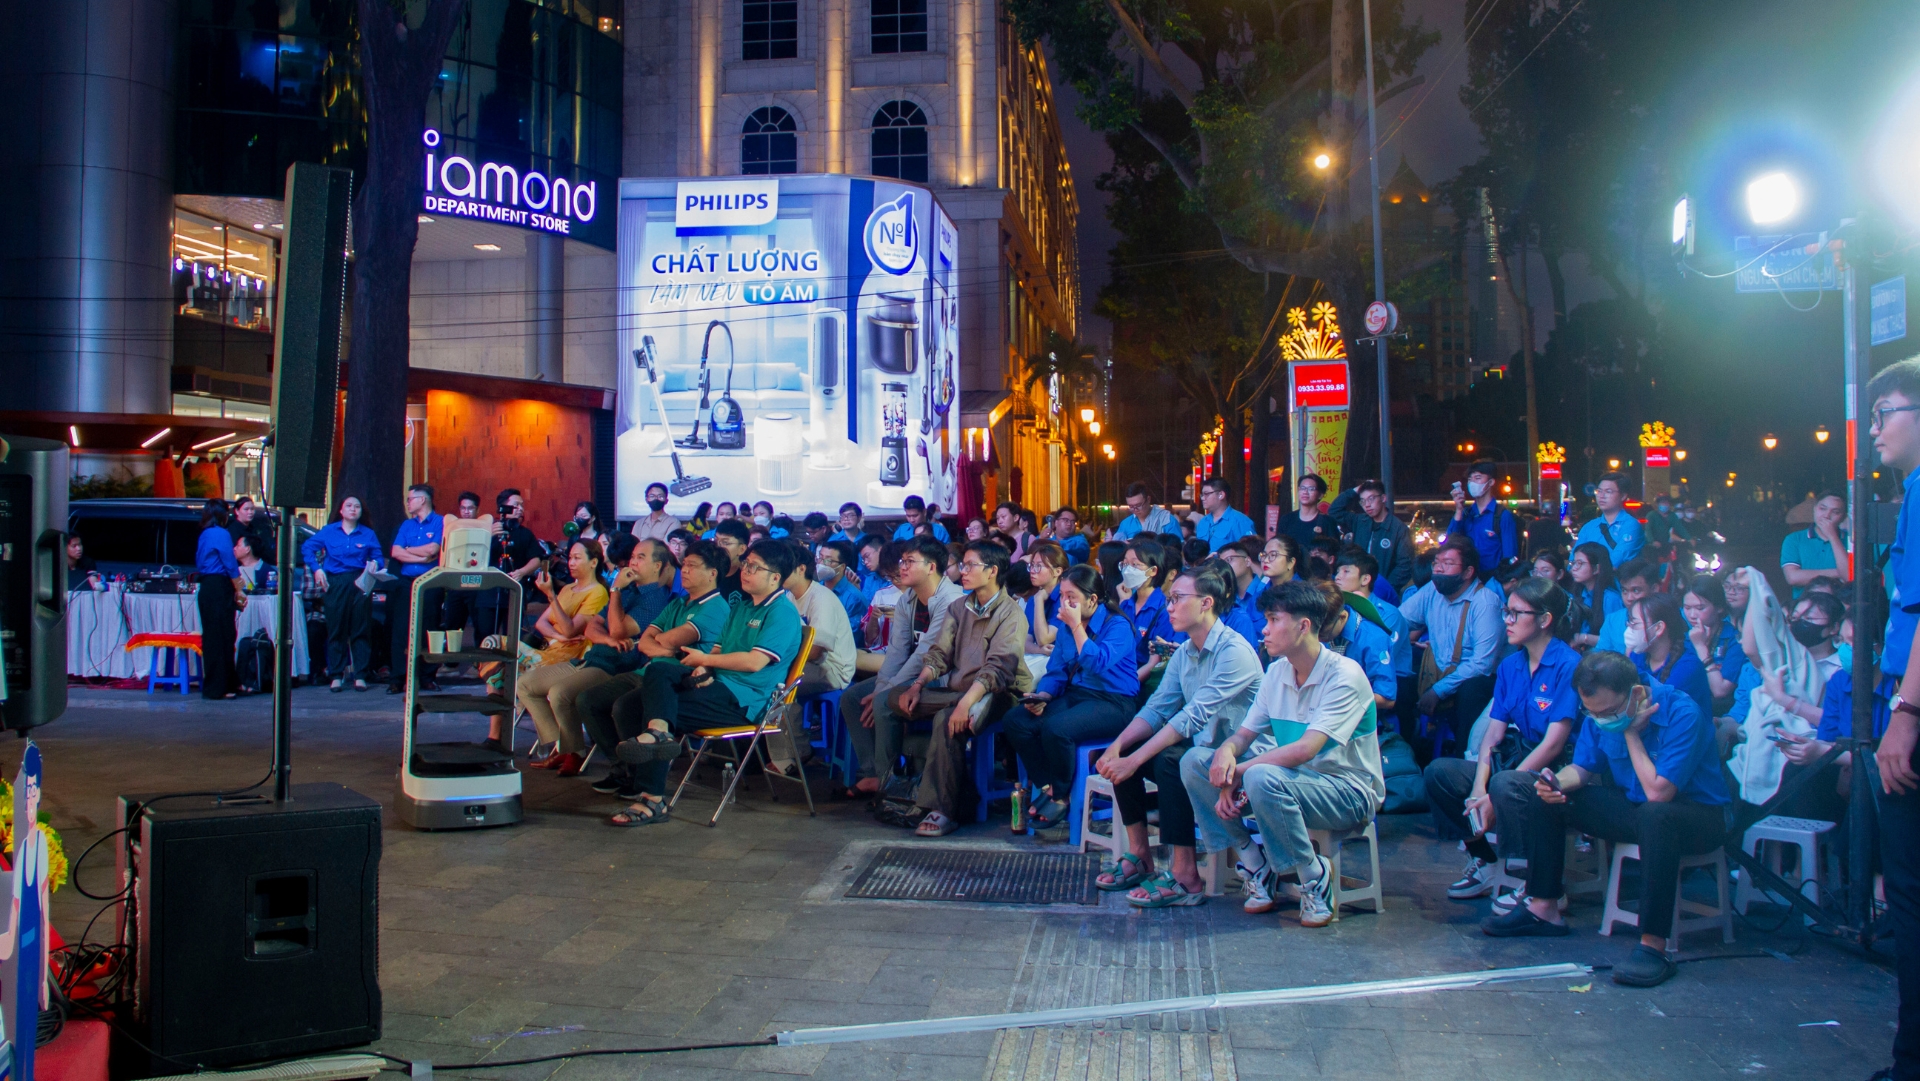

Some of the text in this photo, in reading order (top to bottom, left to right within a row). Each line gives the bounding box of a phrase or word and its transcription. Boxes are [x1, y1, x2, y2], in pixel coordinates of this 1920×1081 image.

[424, 129, 596, 222] iamond
[425, 196, 570, 234] DEPARTMENT STORE
[686, 193, 769, 211] PHILIPS
[175, 258, 263, 290] SISLEY
[652, 245, 818, 277] CHẤT LƯỢNG
[461, 575, 482, 584] UEH
